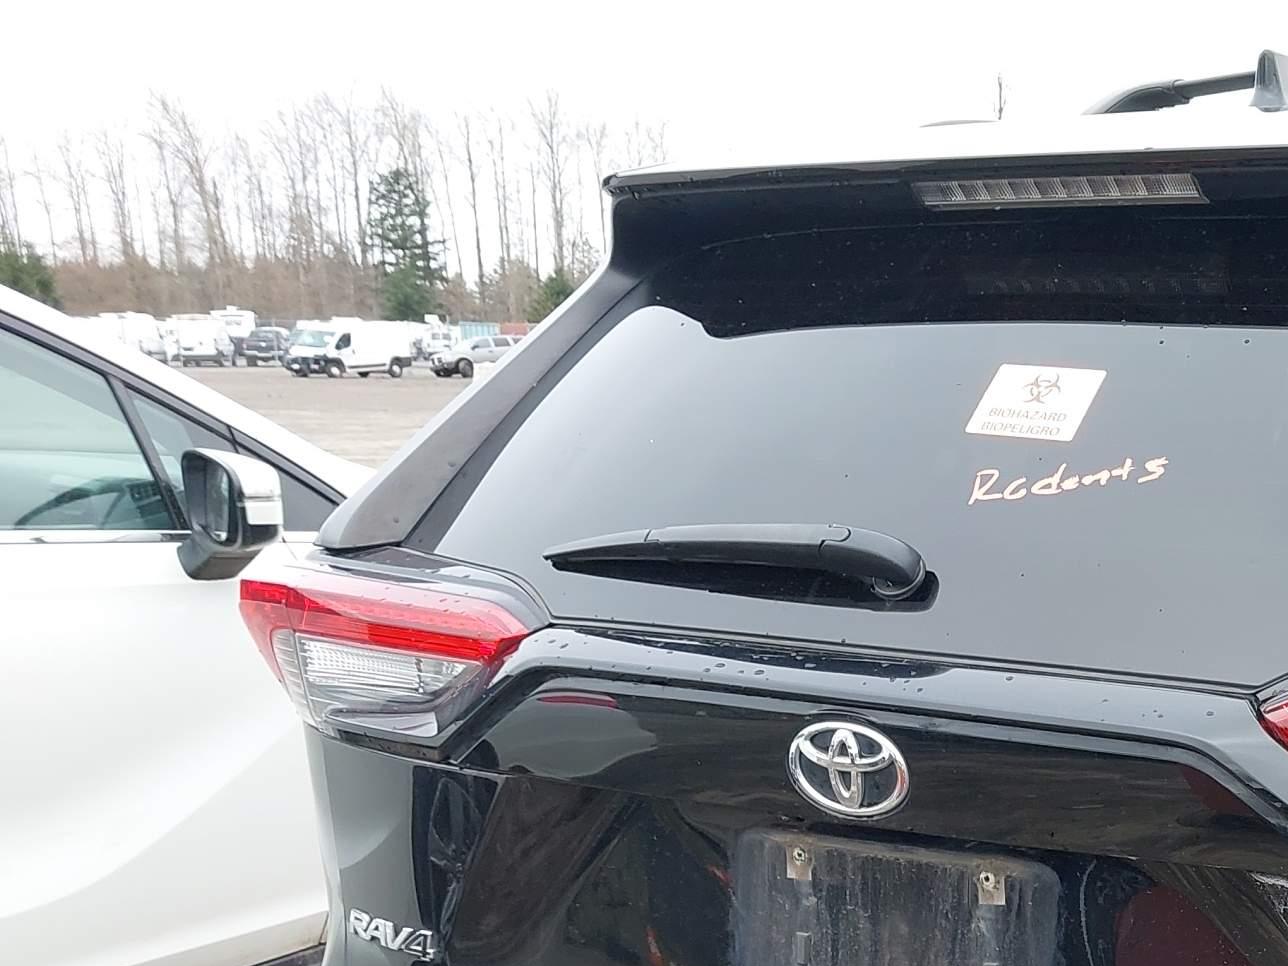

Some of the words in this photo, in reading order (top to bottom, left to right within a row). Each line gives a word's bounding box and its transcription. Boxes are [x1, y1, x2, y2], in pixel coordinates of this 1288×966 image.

[988, 407, 1067, 422] BIOHAZARD
[981, 421, 1061, 436] BIOPELIGRO
[349, 908, 436, 962] RAV4
